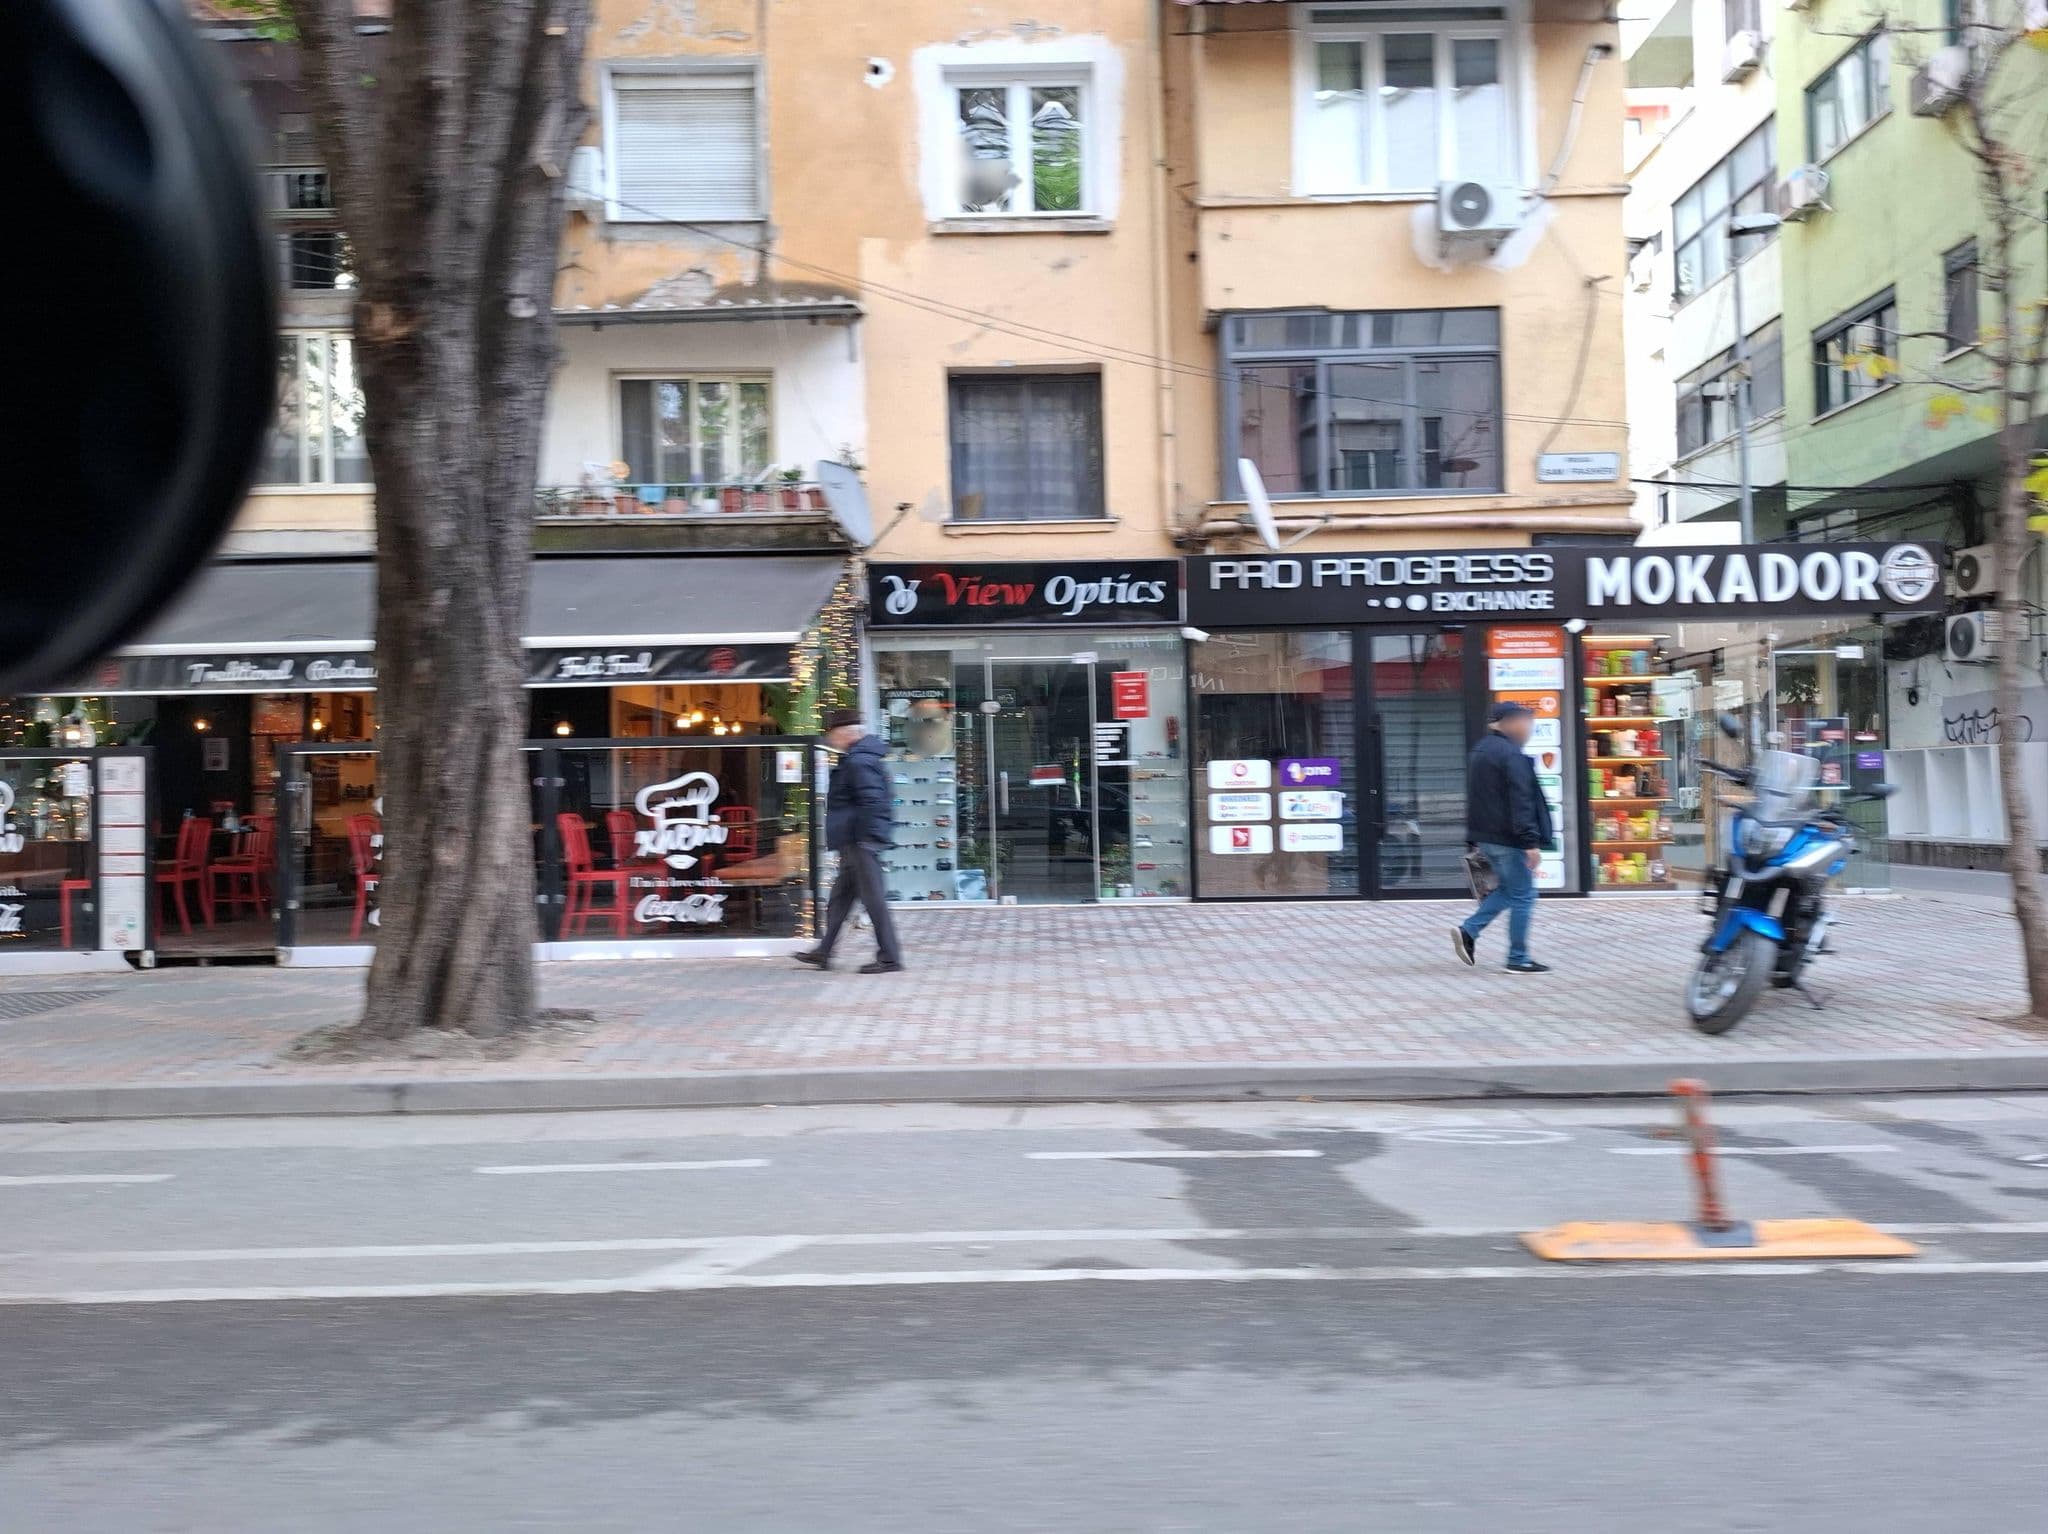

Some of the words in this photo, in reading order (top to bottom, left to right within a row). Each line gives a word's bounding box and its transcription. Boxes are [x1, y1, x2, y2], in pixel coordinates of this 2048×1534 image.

[1209, 559, 1302, 589] PRO
[1311, 553, 1554, 588] PROGRESS
[1585, 551, 1881, 606] MOKADOR
[930, 573, 1035, 606] View
[1043, 573, 1167, 616] Optics
[1431, 590, 1555, 612] EXCHANGE
